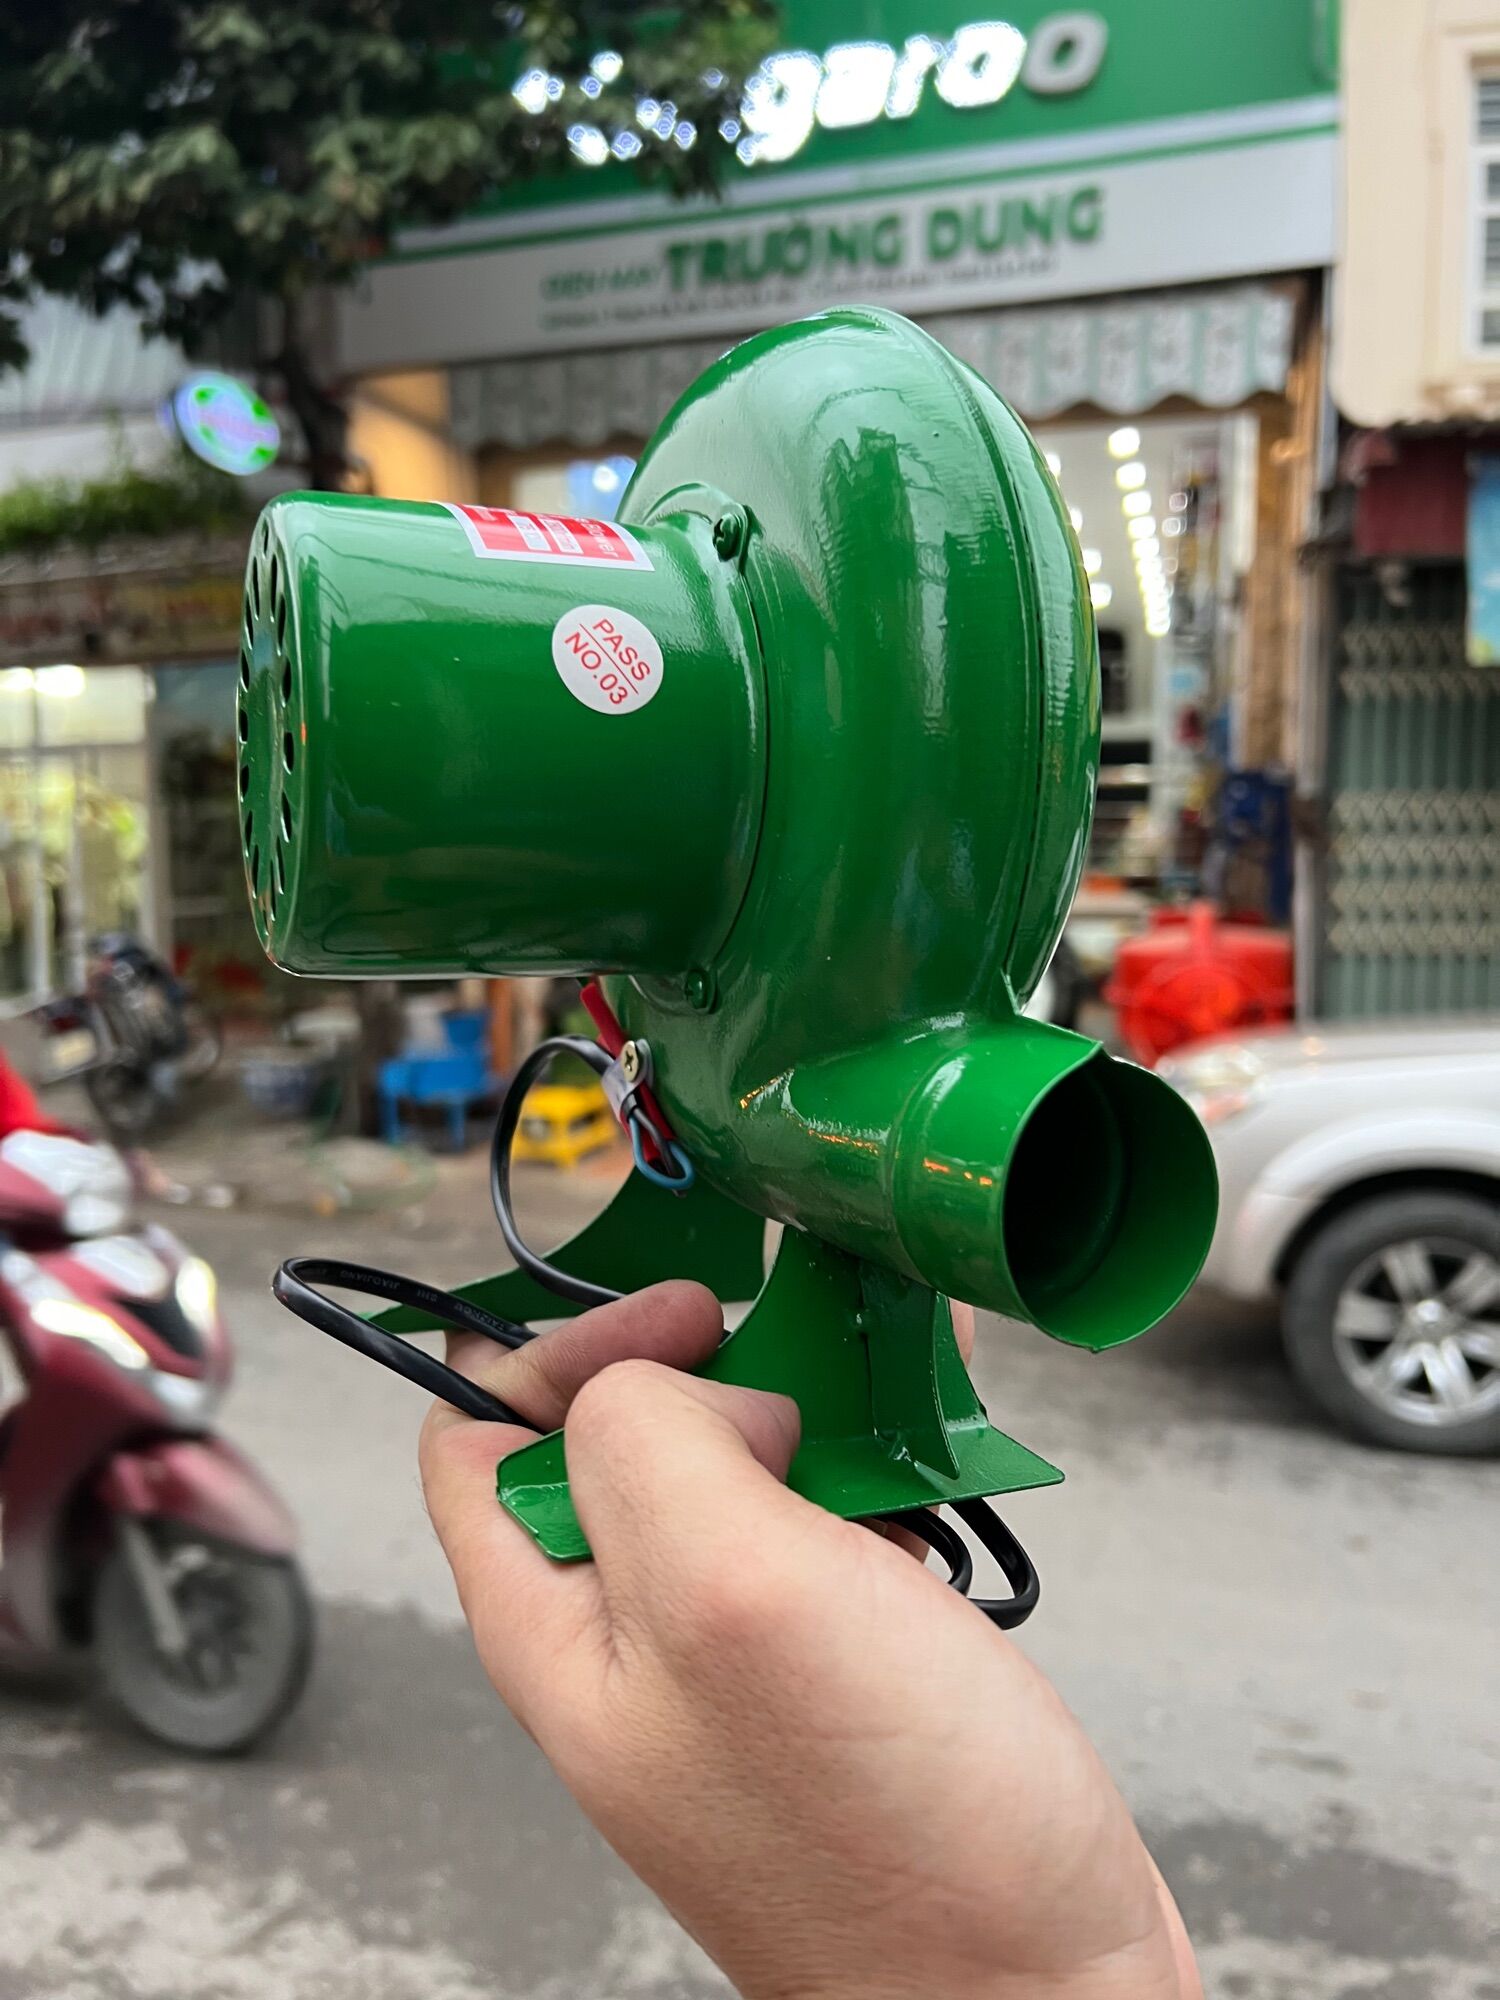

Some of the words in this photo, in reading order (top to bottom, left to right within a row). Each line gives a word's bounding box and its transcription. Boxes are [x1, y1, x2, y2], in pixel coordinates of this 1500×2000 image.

[512, 11, 1109, 166] garoo
[564, 631, 628, 705] NO.03
[592, 618, 651, 681] PASS
